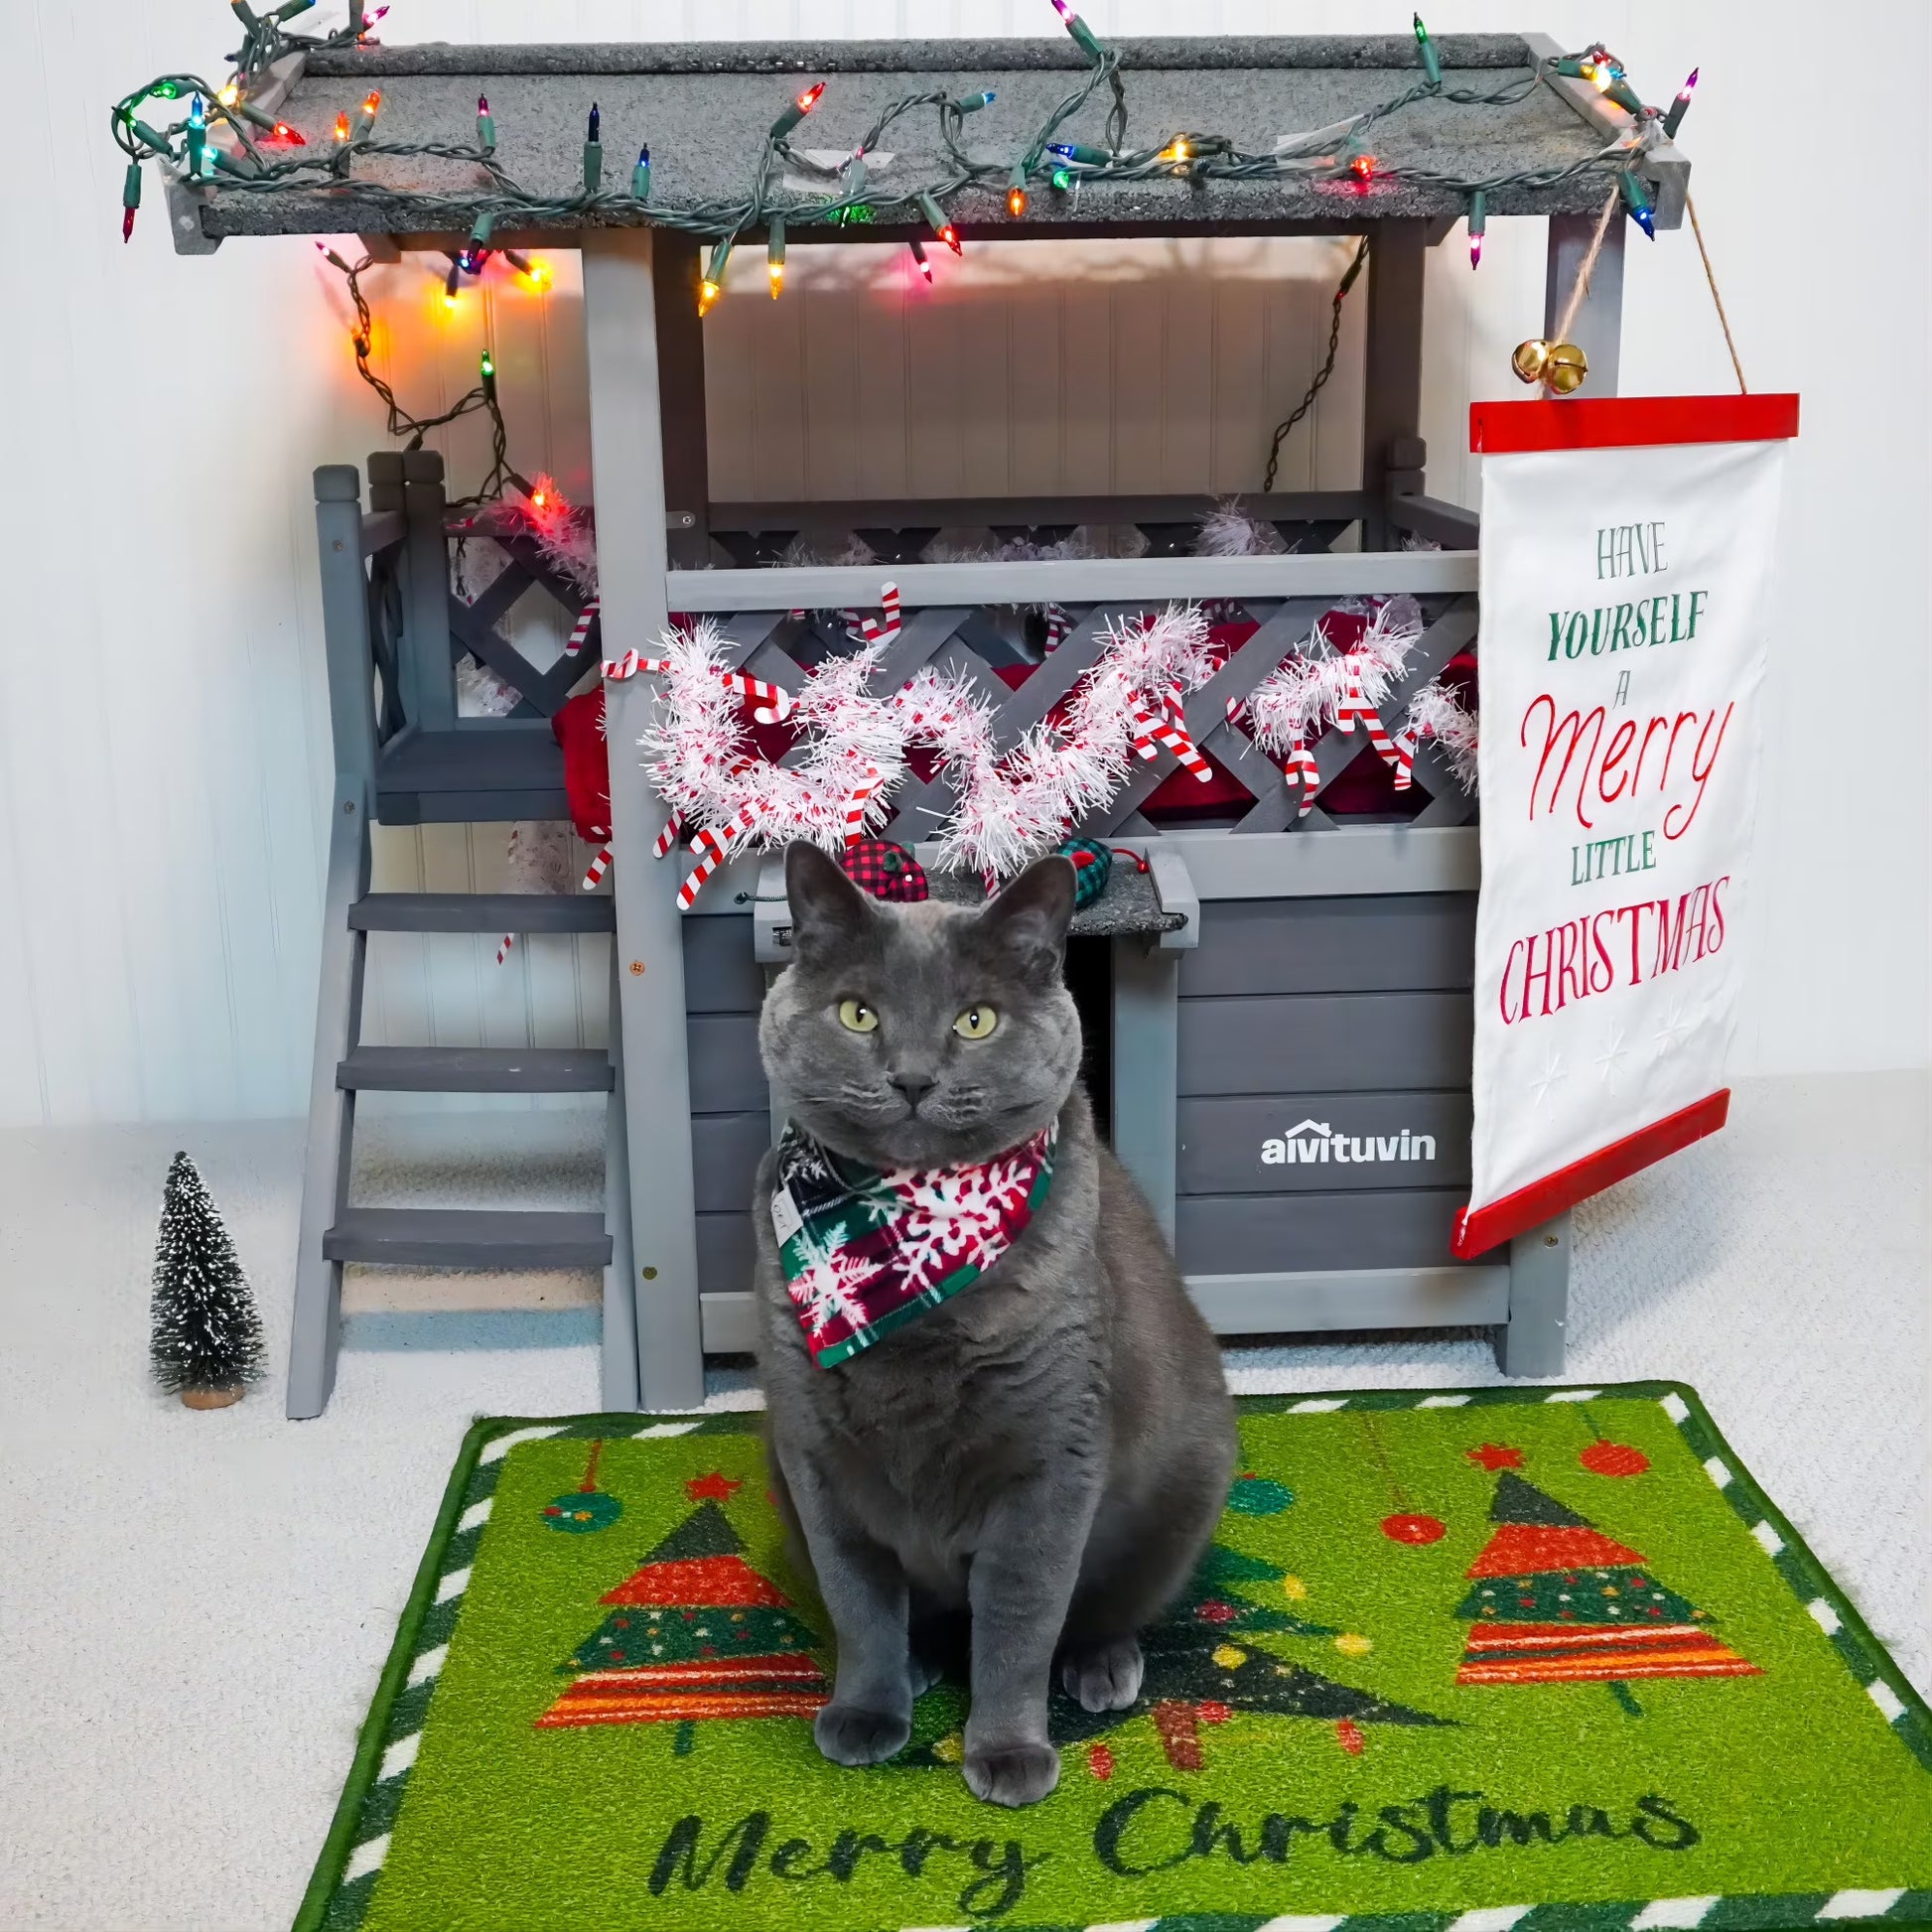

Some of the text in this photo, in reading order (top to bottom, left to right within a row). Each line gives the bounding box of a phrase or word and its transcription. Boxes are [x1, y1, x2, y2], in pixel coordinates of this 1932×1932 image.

[1595, 521, 1669, 580] HAVE
[1547, 590, 1709, 661] YOURSELF
[1611, 670, 1631, 710] A
[1520, 694, 1734, 840] Merry
[1570, 830, 1657, 887] LITTLE
[1499, 875, 1730, 1025] CHRISTMAS
[1260, 1119, 1437, 1165] aivituvin
[647, 1786, 1701, 1919] Merry Christmas
